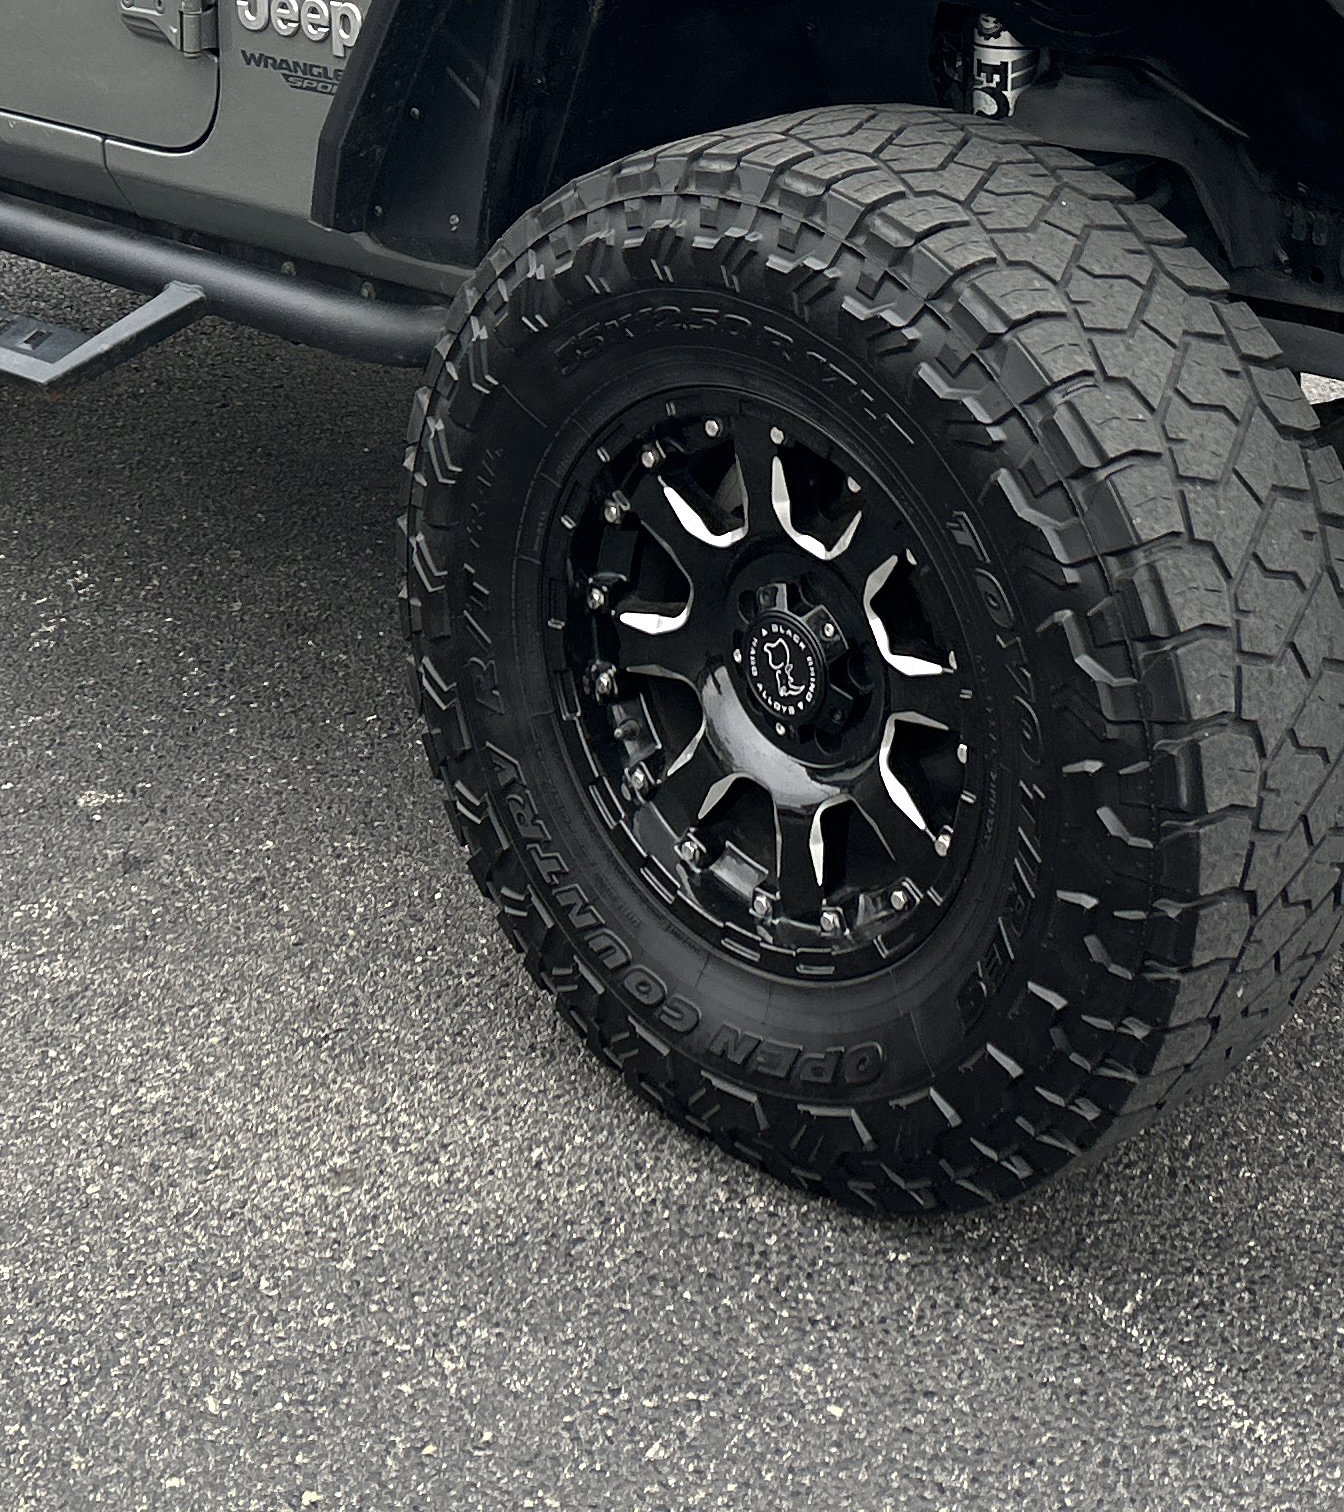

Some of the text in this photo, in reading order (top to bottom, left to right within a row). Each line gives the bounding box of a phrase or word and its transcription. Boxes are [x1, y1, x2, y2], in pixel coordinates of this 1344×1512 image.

[240, 49, 345, 82] WRANGLE
[286, 76, 339, 93] SPO
[771, 623, 816, 703] BLACK RHINO
[945, 510, 1045, 766] TOYO
[483, 740, 702, 1034] COUNTRY
[710, 1024, 884, 1084] OPEN
